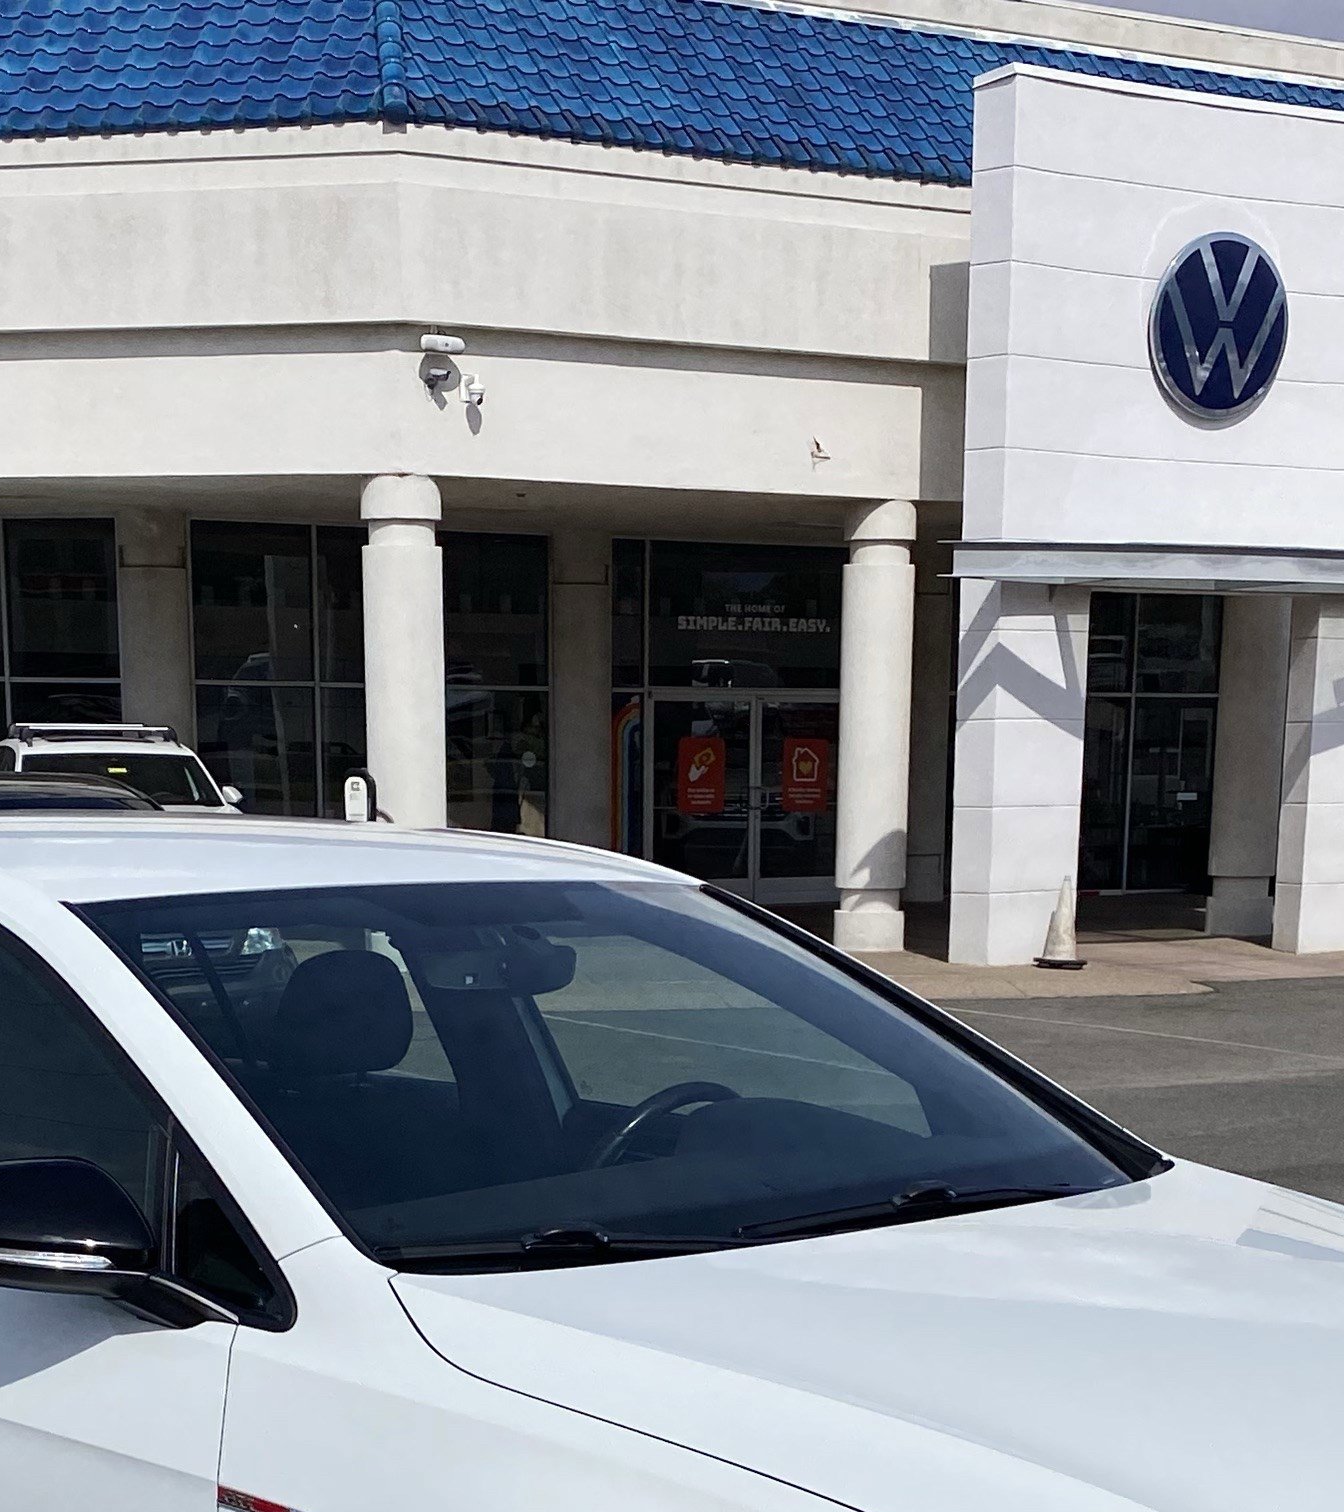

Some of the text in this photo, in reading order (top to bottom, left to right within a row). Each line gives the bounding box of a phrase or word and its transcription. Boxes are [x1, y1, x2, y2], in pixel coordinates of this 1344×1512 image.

[724, 604, 786, 614] THE HOME OF
